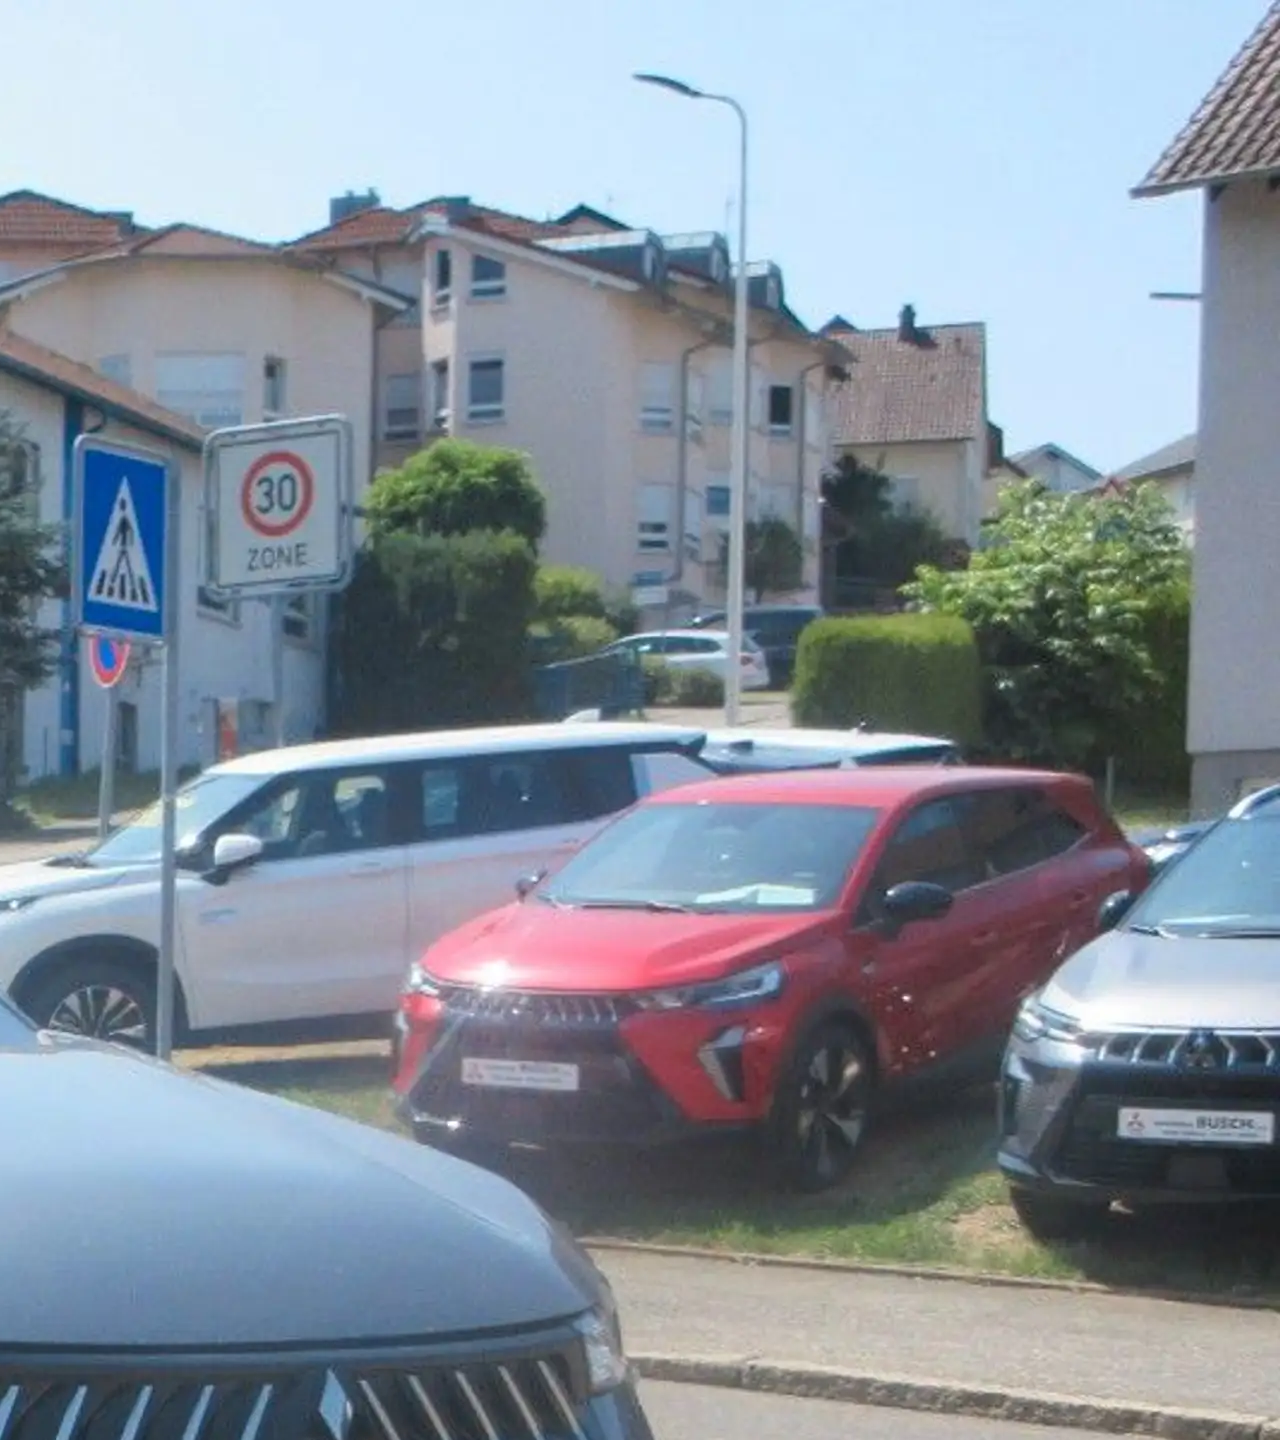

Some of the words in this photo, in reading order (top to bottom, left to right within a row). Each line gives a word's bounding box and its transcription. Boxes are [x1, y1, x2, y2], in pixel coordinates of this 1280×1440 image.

[255, 472, 297, 514] 30
[247, 542, 308, 571] ZONE
[1196, 1116, 1256, 1130] BUSCH
